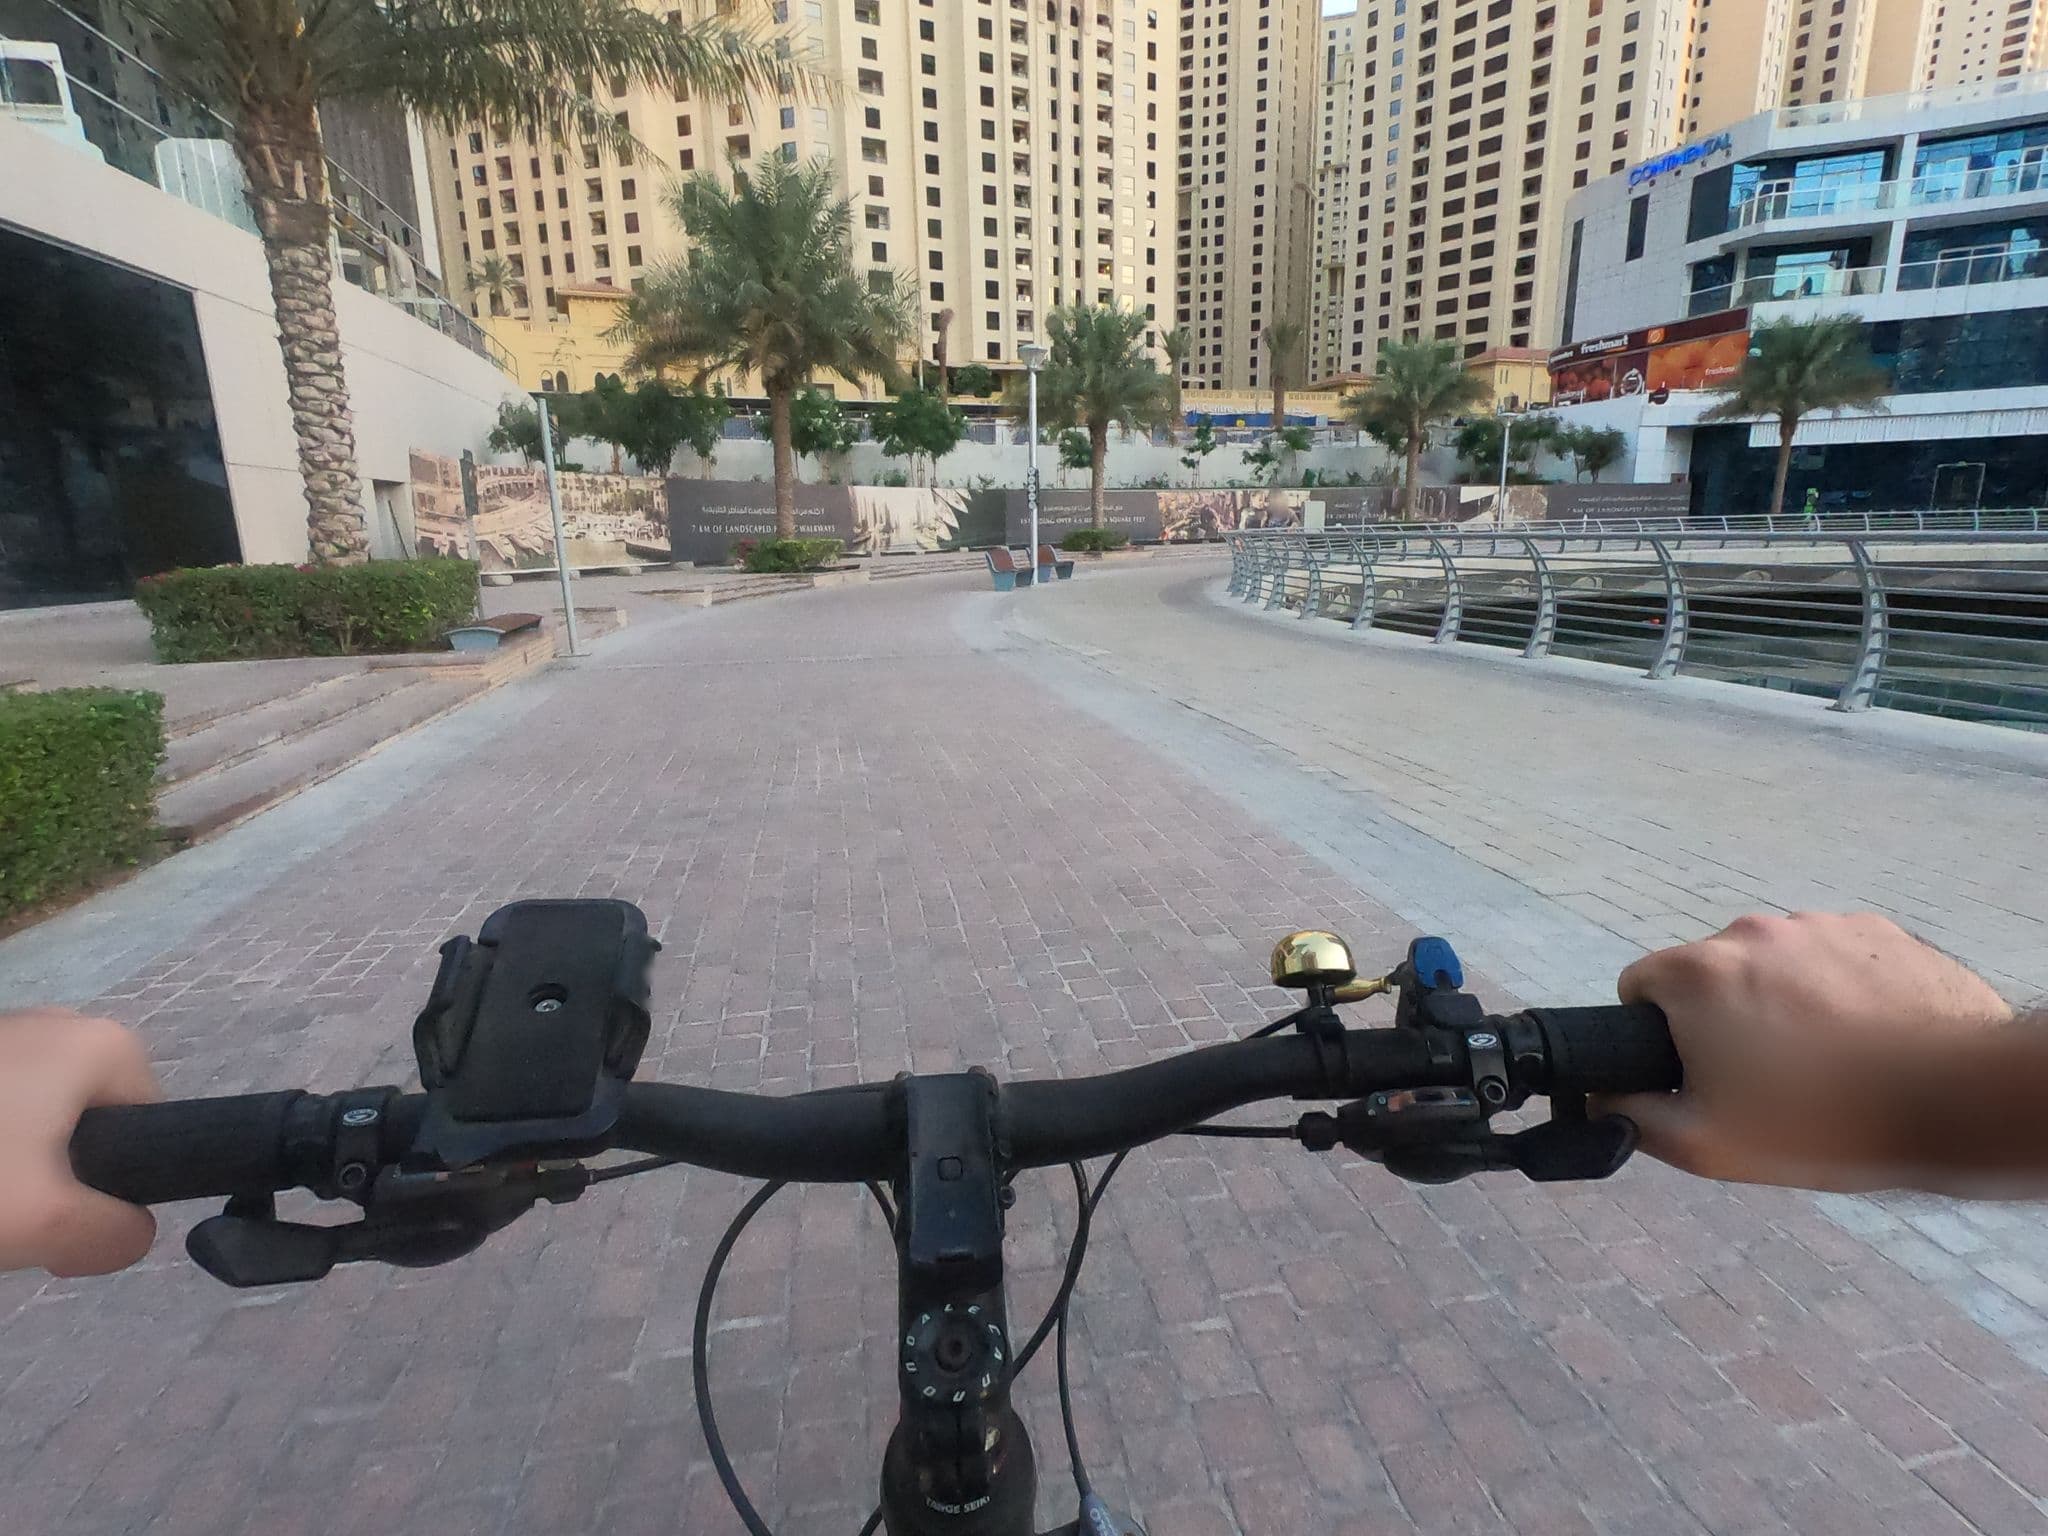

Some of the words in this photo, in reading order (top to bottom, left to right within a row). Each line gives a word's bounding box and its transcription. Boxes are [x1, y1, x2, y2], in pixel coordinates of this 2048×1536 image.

[1581, 335, 1629, 354] freshmart
[713, 525, 722, 533] OF
[725, 524, 771, 533] LANDSCAPED
[963, 1495, 990, 1513] SEIKI
